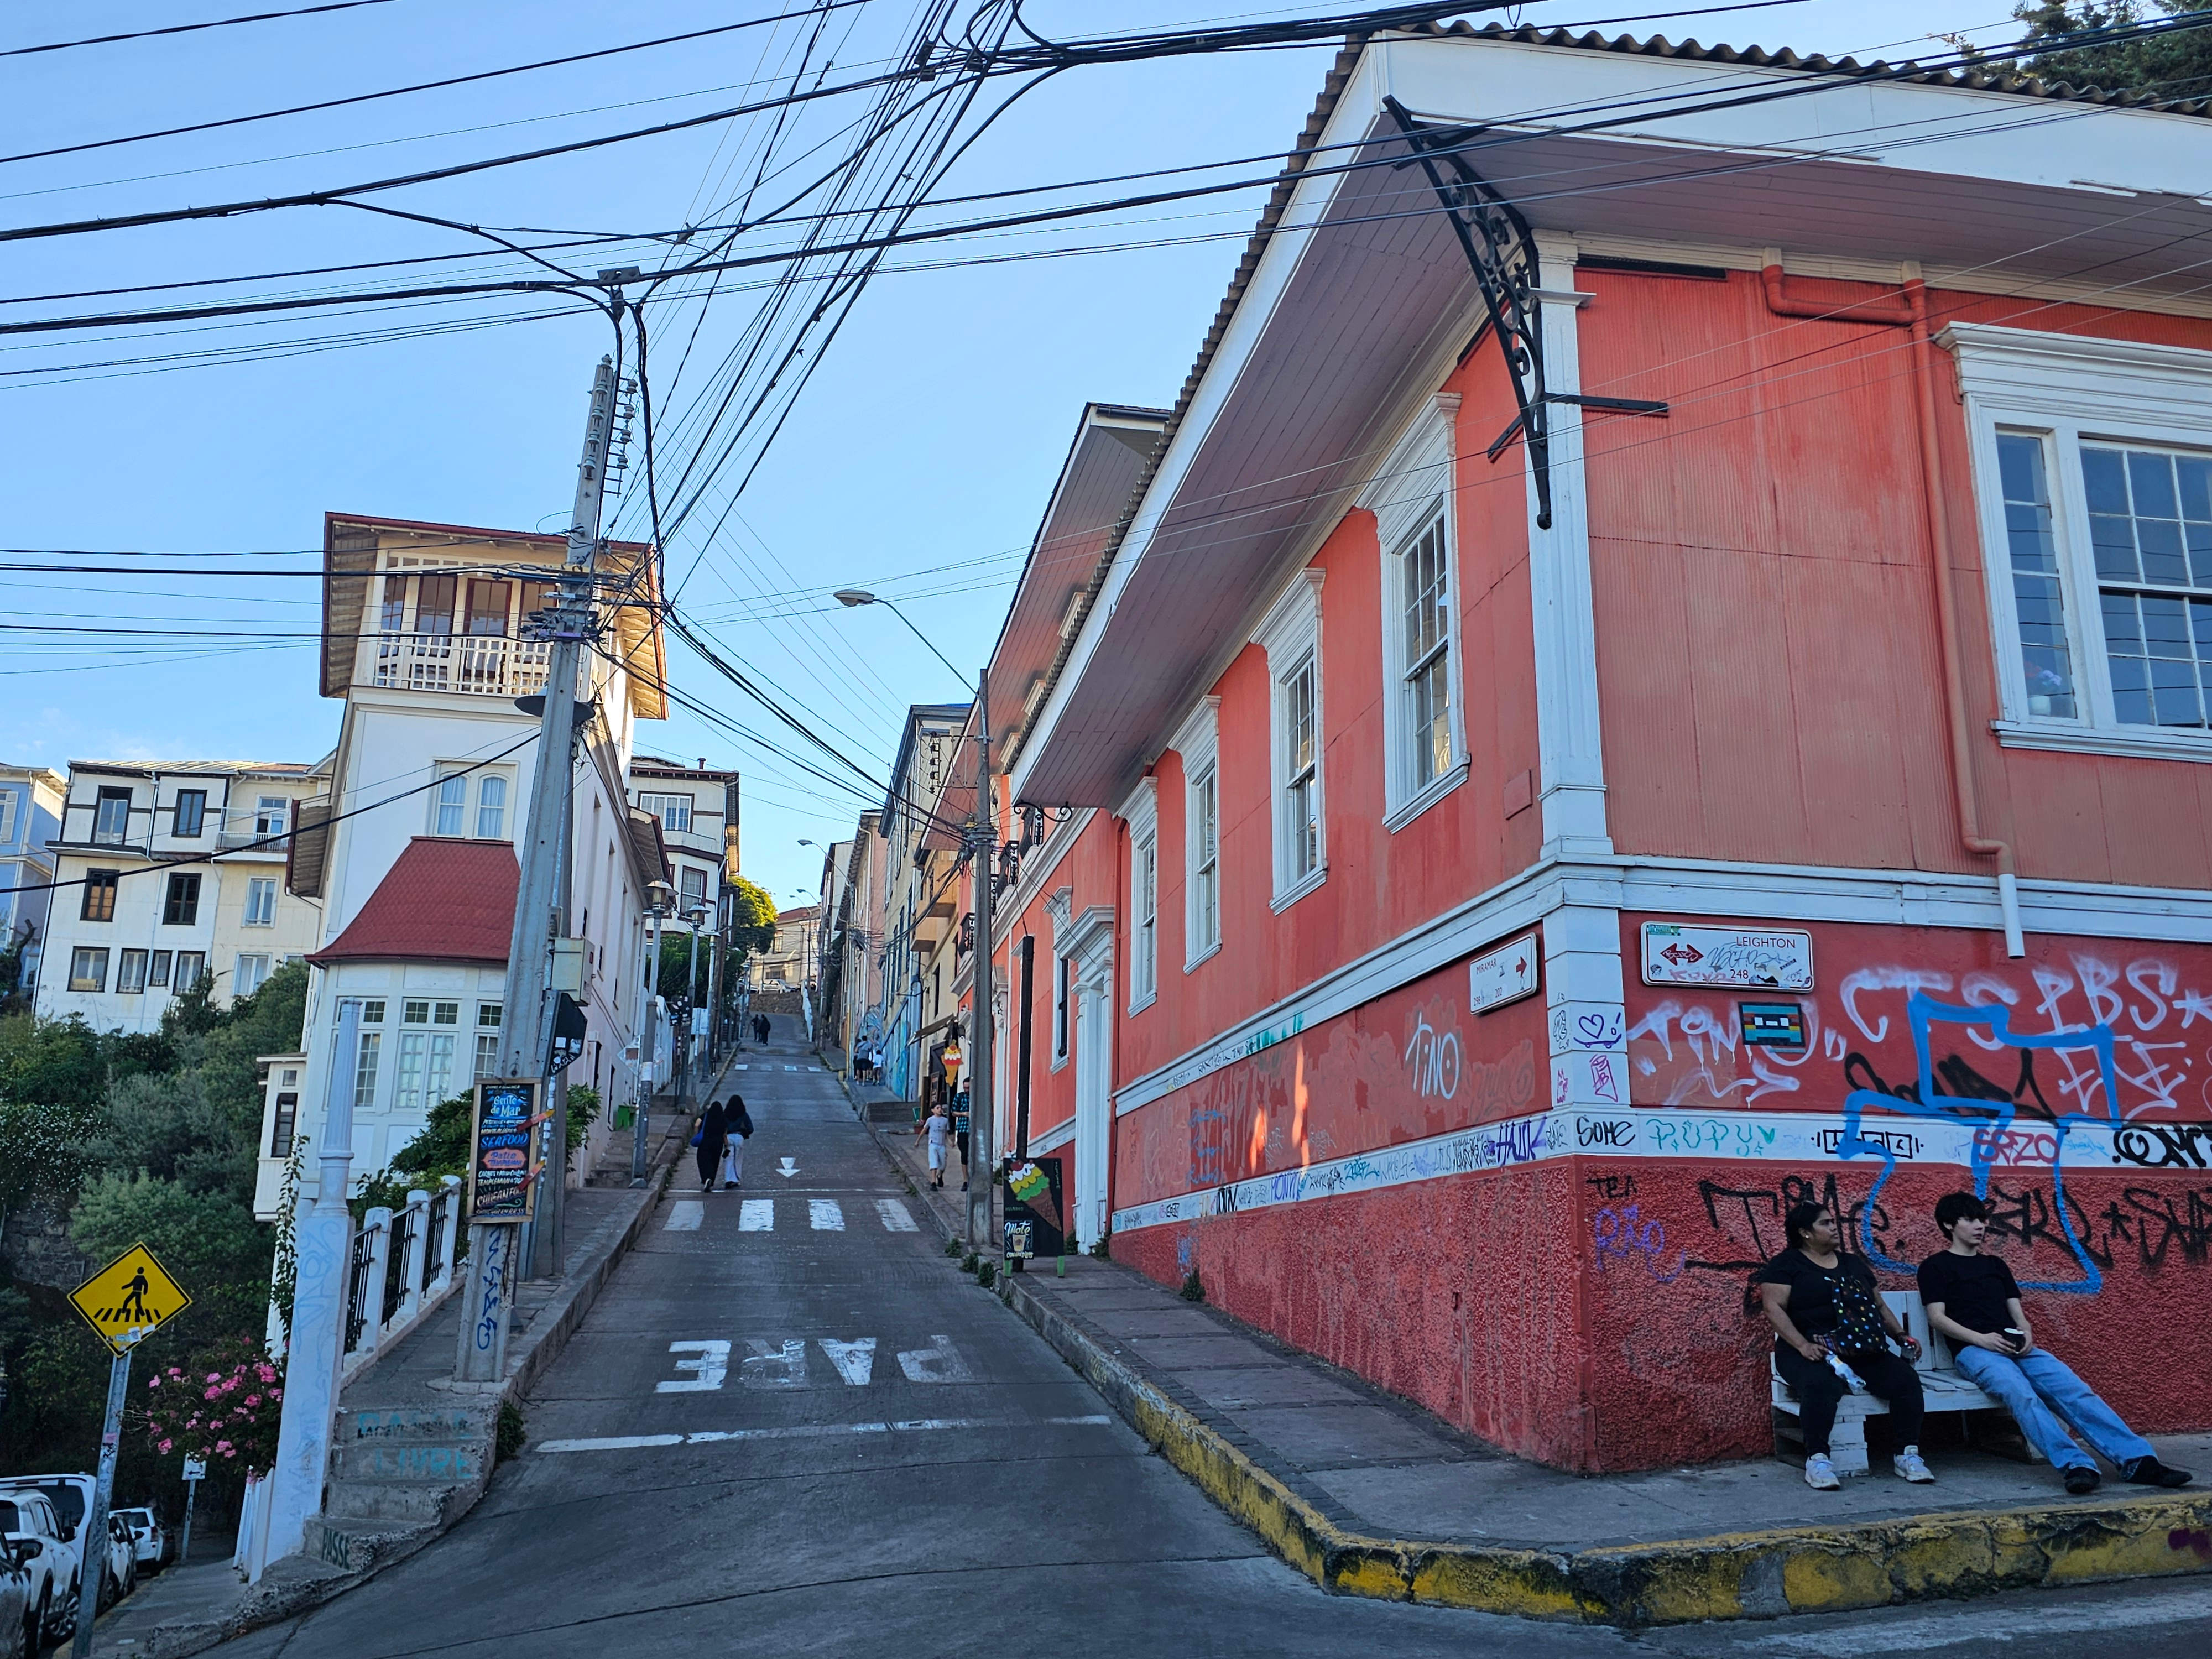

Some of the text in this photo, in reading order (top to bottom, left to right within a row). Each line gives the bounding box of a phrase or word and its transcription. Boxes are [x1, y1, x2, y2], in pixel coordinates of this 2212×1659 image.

[1736, 936, 1796, 948] LEIGHTON
[1477, 958, 1496, 974] MIRAMAR
[1730, 969, 1749, 979] 248
[491, 1106, 521, 1117] de Mar
[481, 1133, 528, 1147] SEAFOOD
[477, 1189, 509, 1207] CHILEAN
